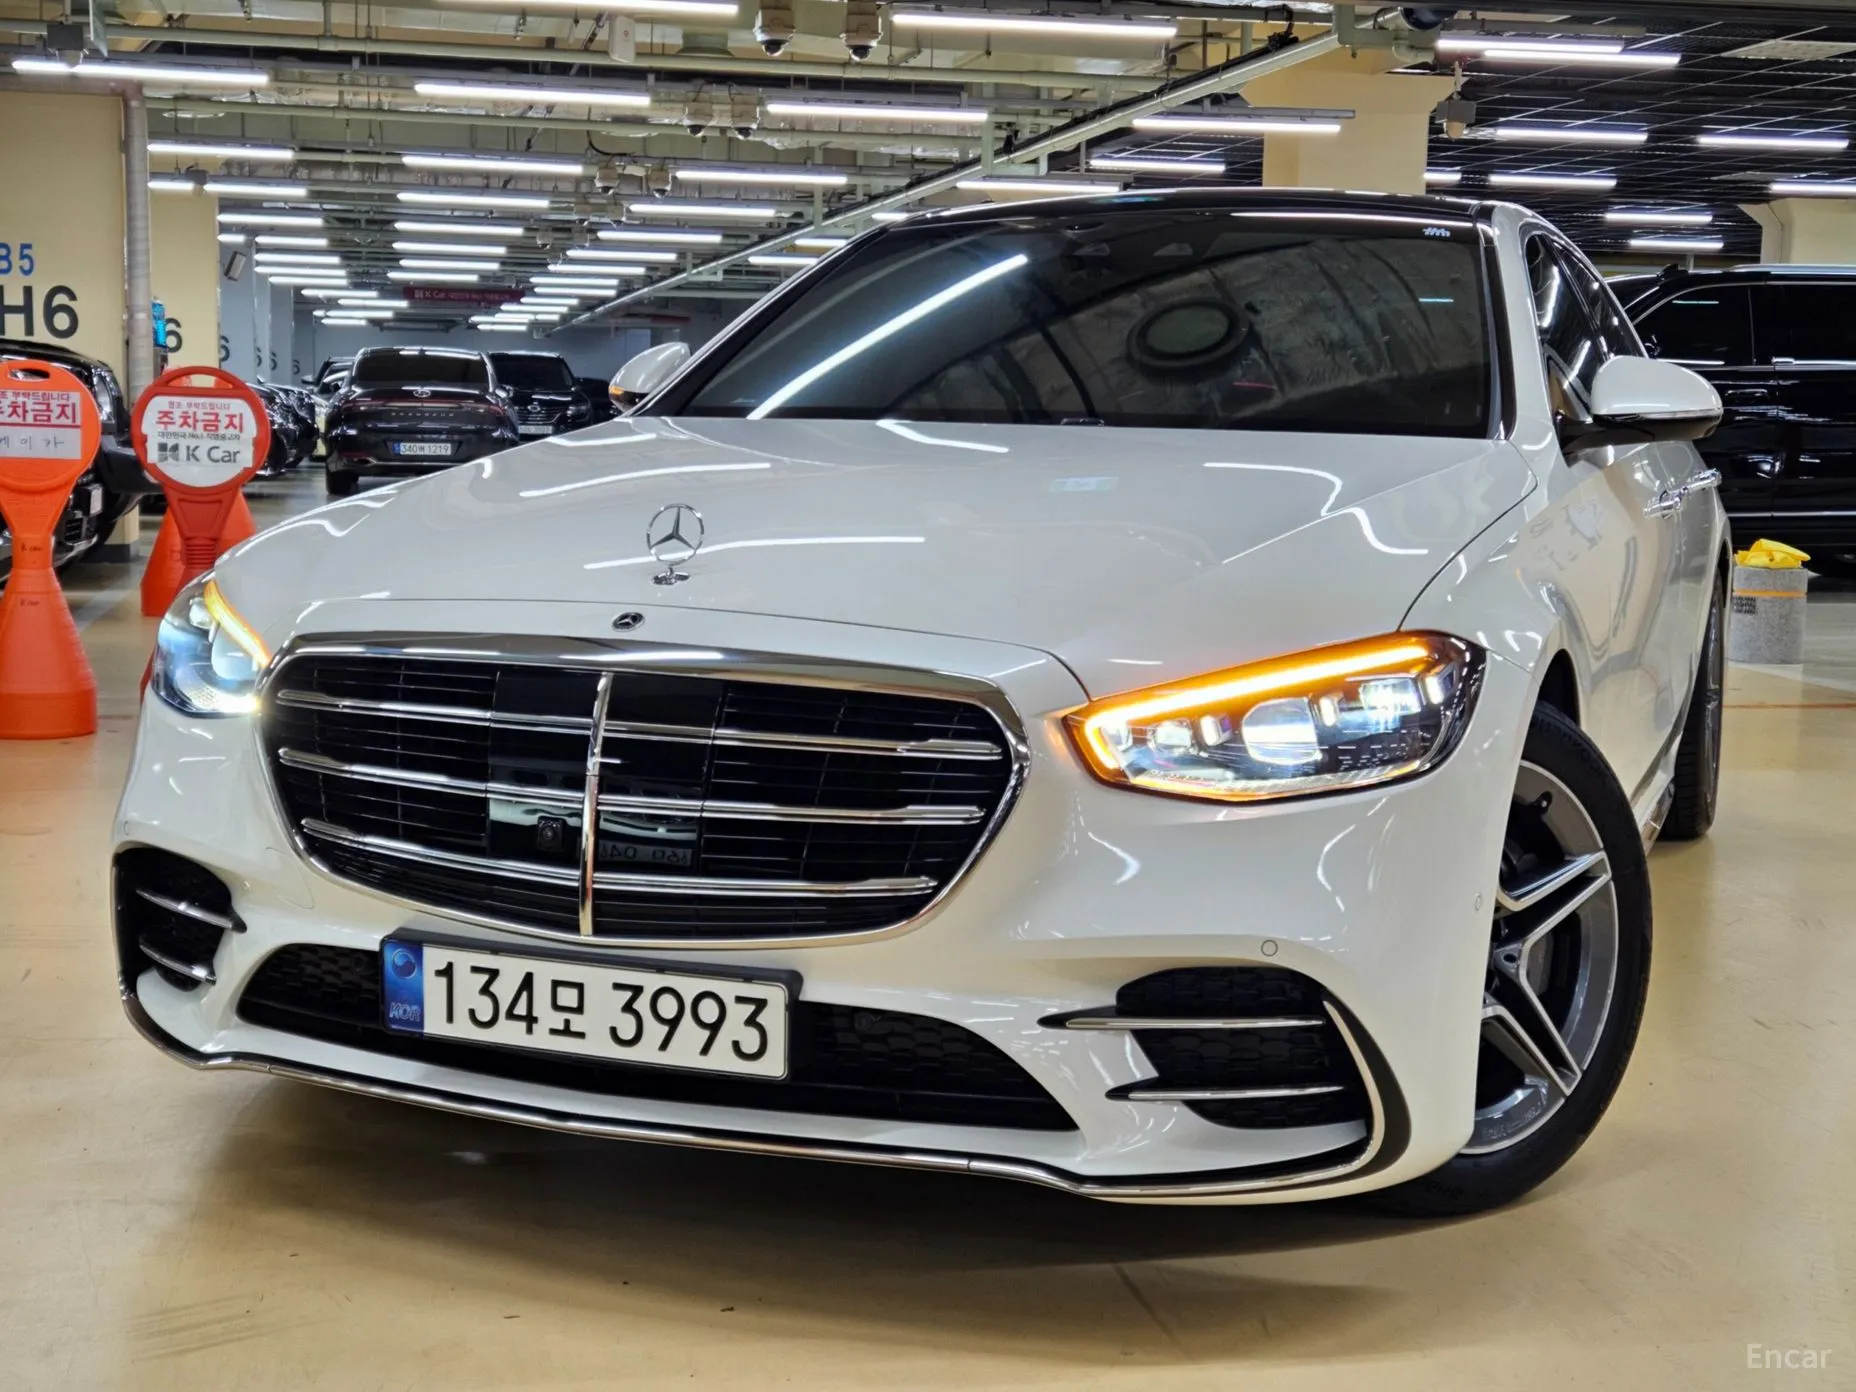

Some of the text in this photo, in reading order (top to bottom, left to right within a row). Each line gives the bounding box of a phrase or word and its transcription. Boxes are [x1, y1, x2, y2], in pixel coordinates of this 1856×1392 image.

[0, 285, 79, 339] H6
[0, 400, 76, 424] 차금지
[156, 411, 243, 433] 주차금지
[185, 445, 241, 463] K Car
[389, 1002, 421, 1022] KOR
[434, 961, 768, 1062] 134모 3993
